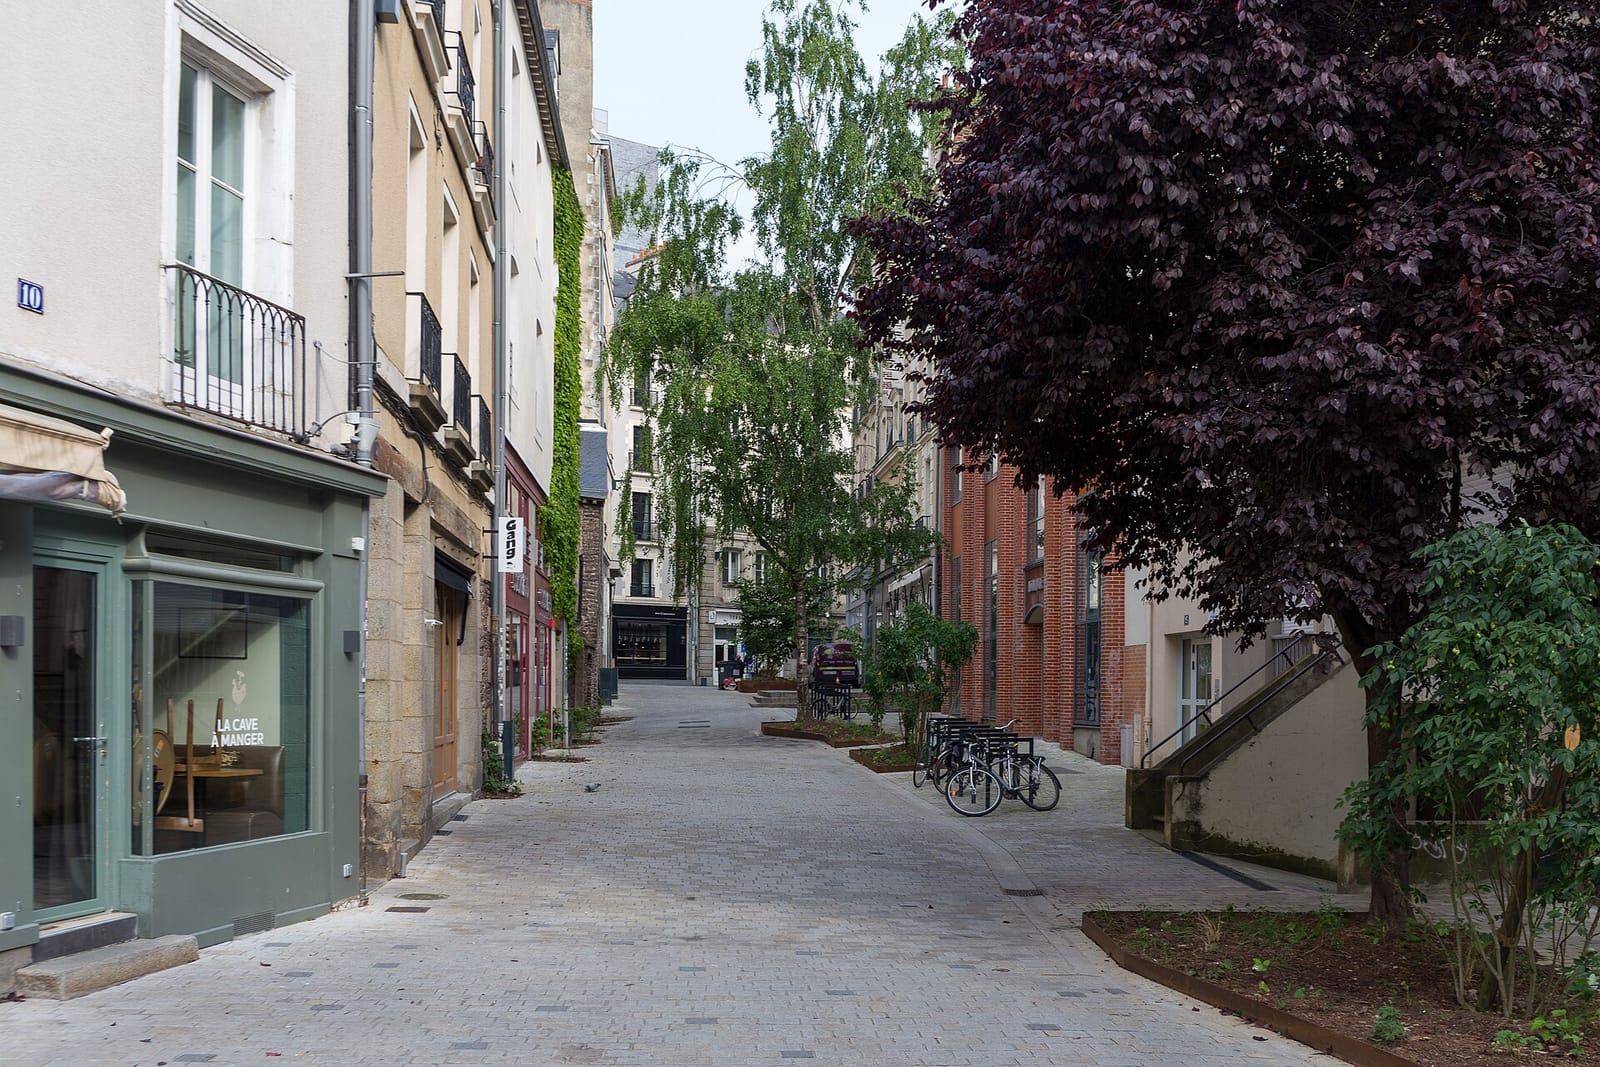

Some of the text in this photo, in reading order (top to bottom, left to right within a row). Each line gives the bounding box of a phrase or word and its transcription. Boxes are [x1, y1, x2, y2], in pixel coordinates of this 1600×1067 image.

[22, 284, 41, 309] 10
[505, 519, 517, 560] Gang
[217, 718, 259, 731] LA CAVE
[210, 731, 264, 748] À MANGER
